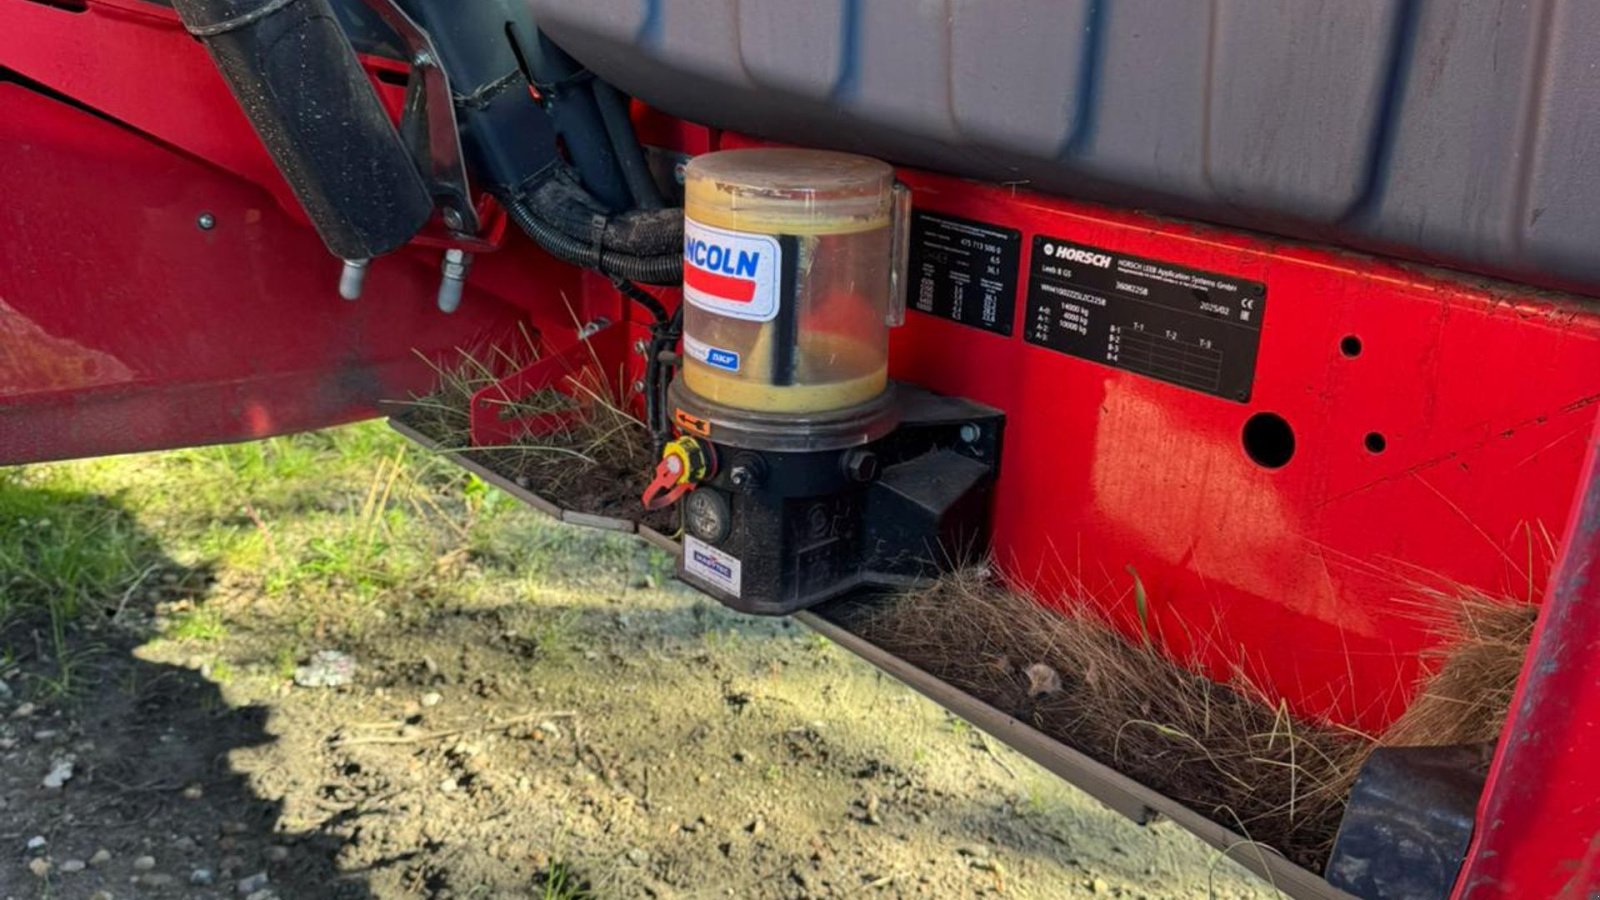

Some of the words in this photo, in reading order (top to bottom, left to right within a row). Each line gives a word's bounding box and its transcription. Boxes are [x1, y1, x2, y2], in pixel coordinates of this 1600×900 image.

[1056, 246, 1112, 269] HORSCH
[1042, 264, 1056, 274] Leeb
[1118, 259, 1142, 271] HORSCH
[1158, 267, 1191, 283] Application
[1192, 275, 1216, 288] Systems
[1217, 281, 1238, 293] GmbH
[1080, 304, 1089, 317] kg
[1199, 301, 1230, 316] 2025/02
[1080, 314, 1089, 327] kg
[1078, 323, 1087, 336] kg
[1109, 325, 1121, 334] B-1
[1133, 322, 1145, 332] T-1
[1108, 334, 1120, 344] B-2
[1165, 330, 1178, 341] T-2
[1107, 343, 1119, 353] B-3
[1199, 338, 1212, 349] T-3
[1106, 352, 1118, 362] B-4
